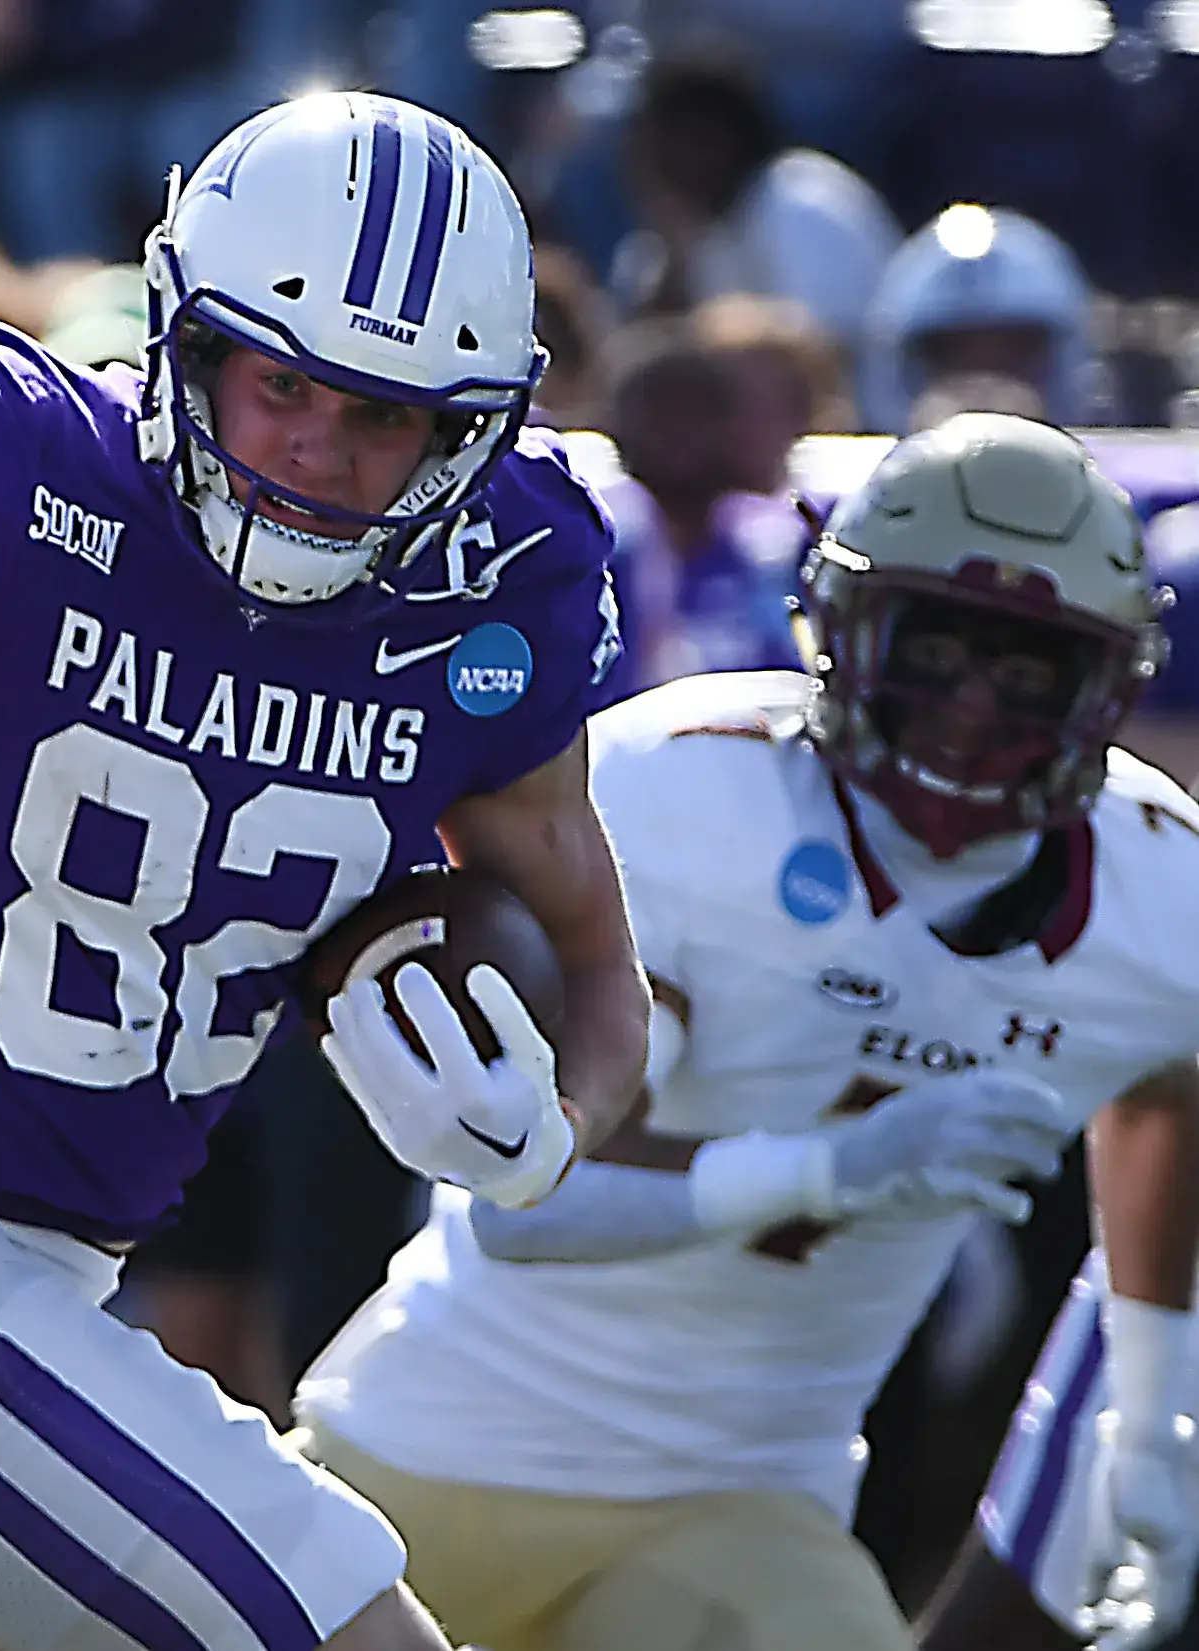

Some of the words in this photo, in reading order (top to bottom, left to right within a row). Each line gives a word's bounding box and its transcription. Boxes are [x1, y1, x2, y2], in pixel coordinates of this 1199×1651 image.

[349, 313, 418, 346] FURMAN
[399, 466, 456, 514] VICIS
[28, 485, 125, 574] SOCON
[47, 605, 425, 784] PALADINS
[456, 666, 525, 694] NCAA
